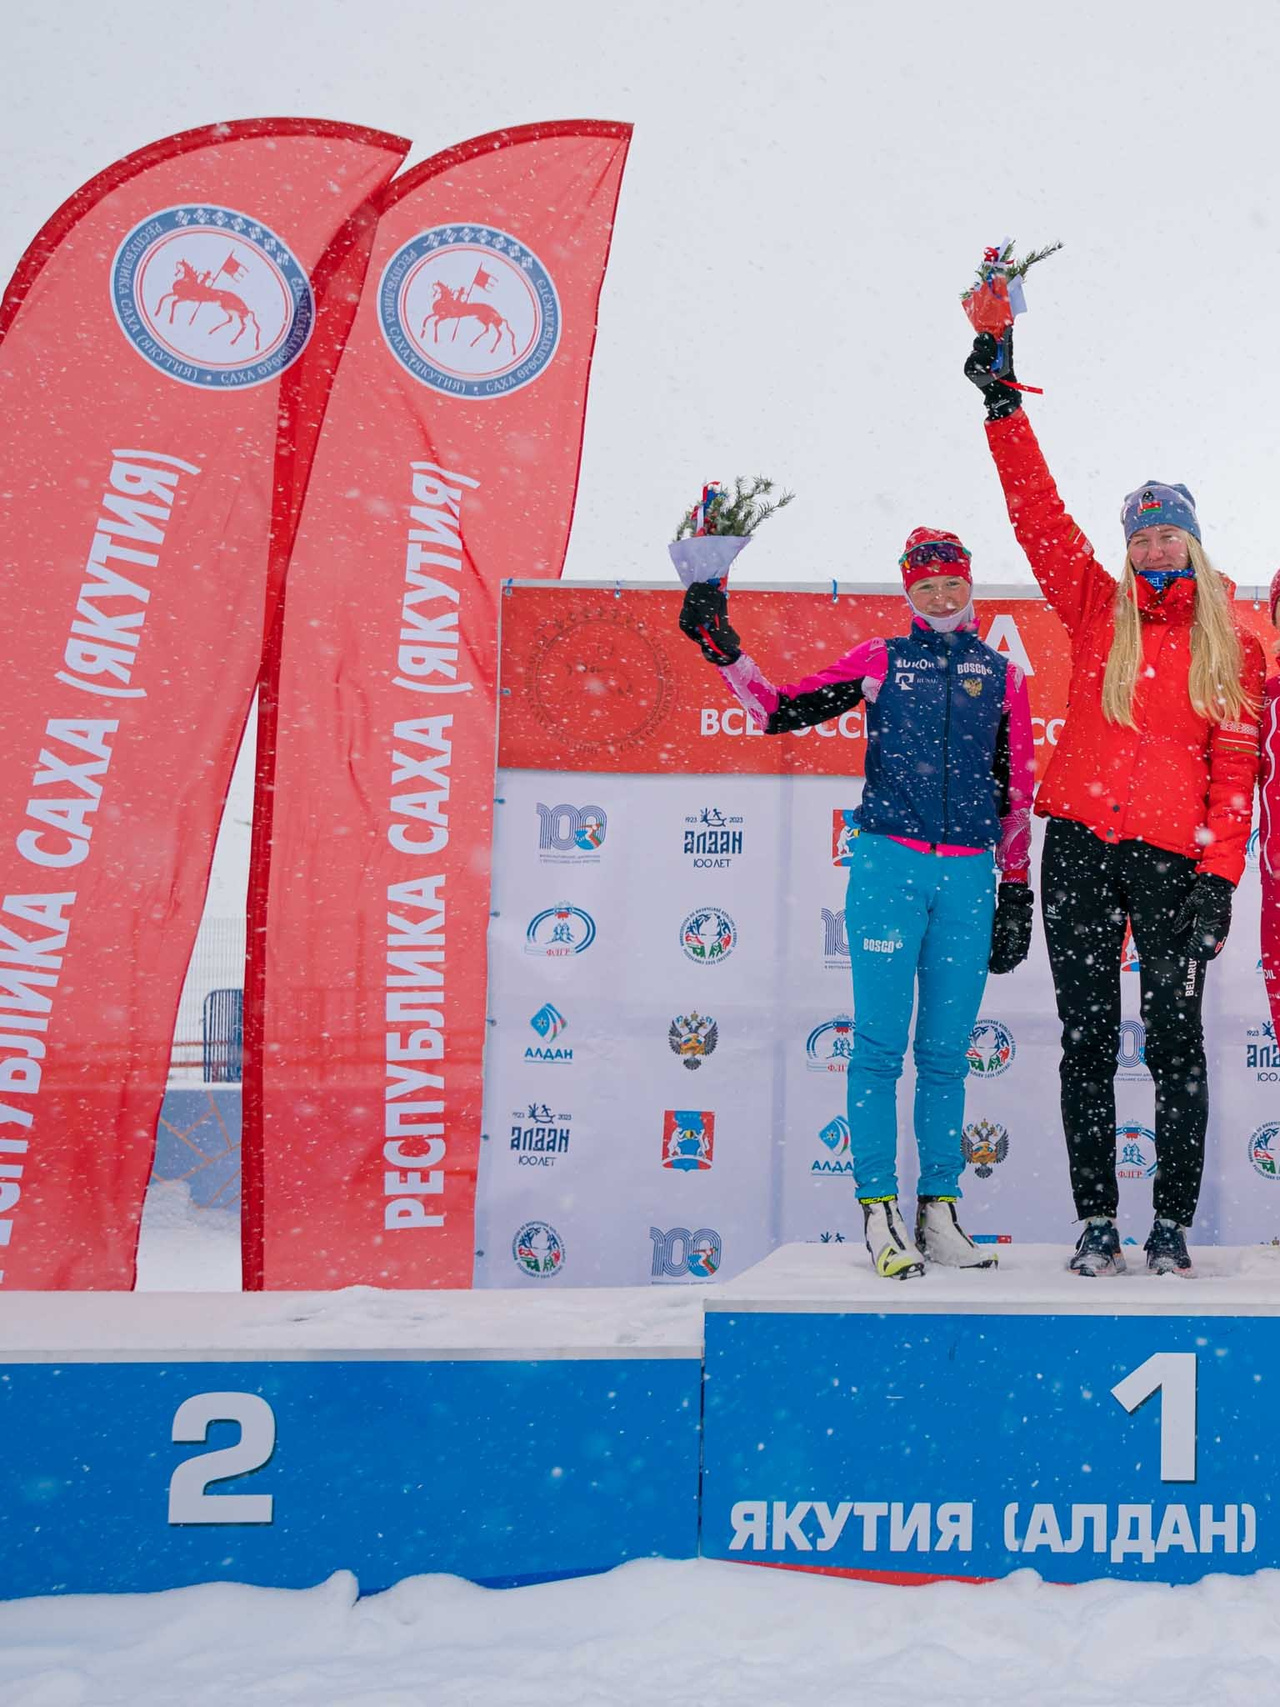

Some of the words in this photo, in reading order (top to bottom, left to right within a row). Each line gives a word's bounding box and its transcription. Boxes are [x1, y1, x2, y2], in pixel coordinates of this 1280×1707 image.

[55, 448, 201, 698] (ЯКУТИЯ)
[392, 461, 481, 694] (ЯКУТИЯ)
[16, 718, 120, 868] САХА
[387, 714, 454, 855] САХА
[863, 938, 895, 954] BOSCO
[1185, 957, 1198, 997] BELARU
[384, 875, 446, 1230] РЕСПУБЛИКА
[524, 1047, 573, 1060] АЛДАН
[811, 1160, 854, 1173] АЛДА
[168, 1391, 276, 1525] 2
[1110, 1352, 1198, 1485] 1
[730, 1501, 973, 1552] ЯКУТИЯ
[1003, 1501, 1256, 1564] (АЛДАН)
